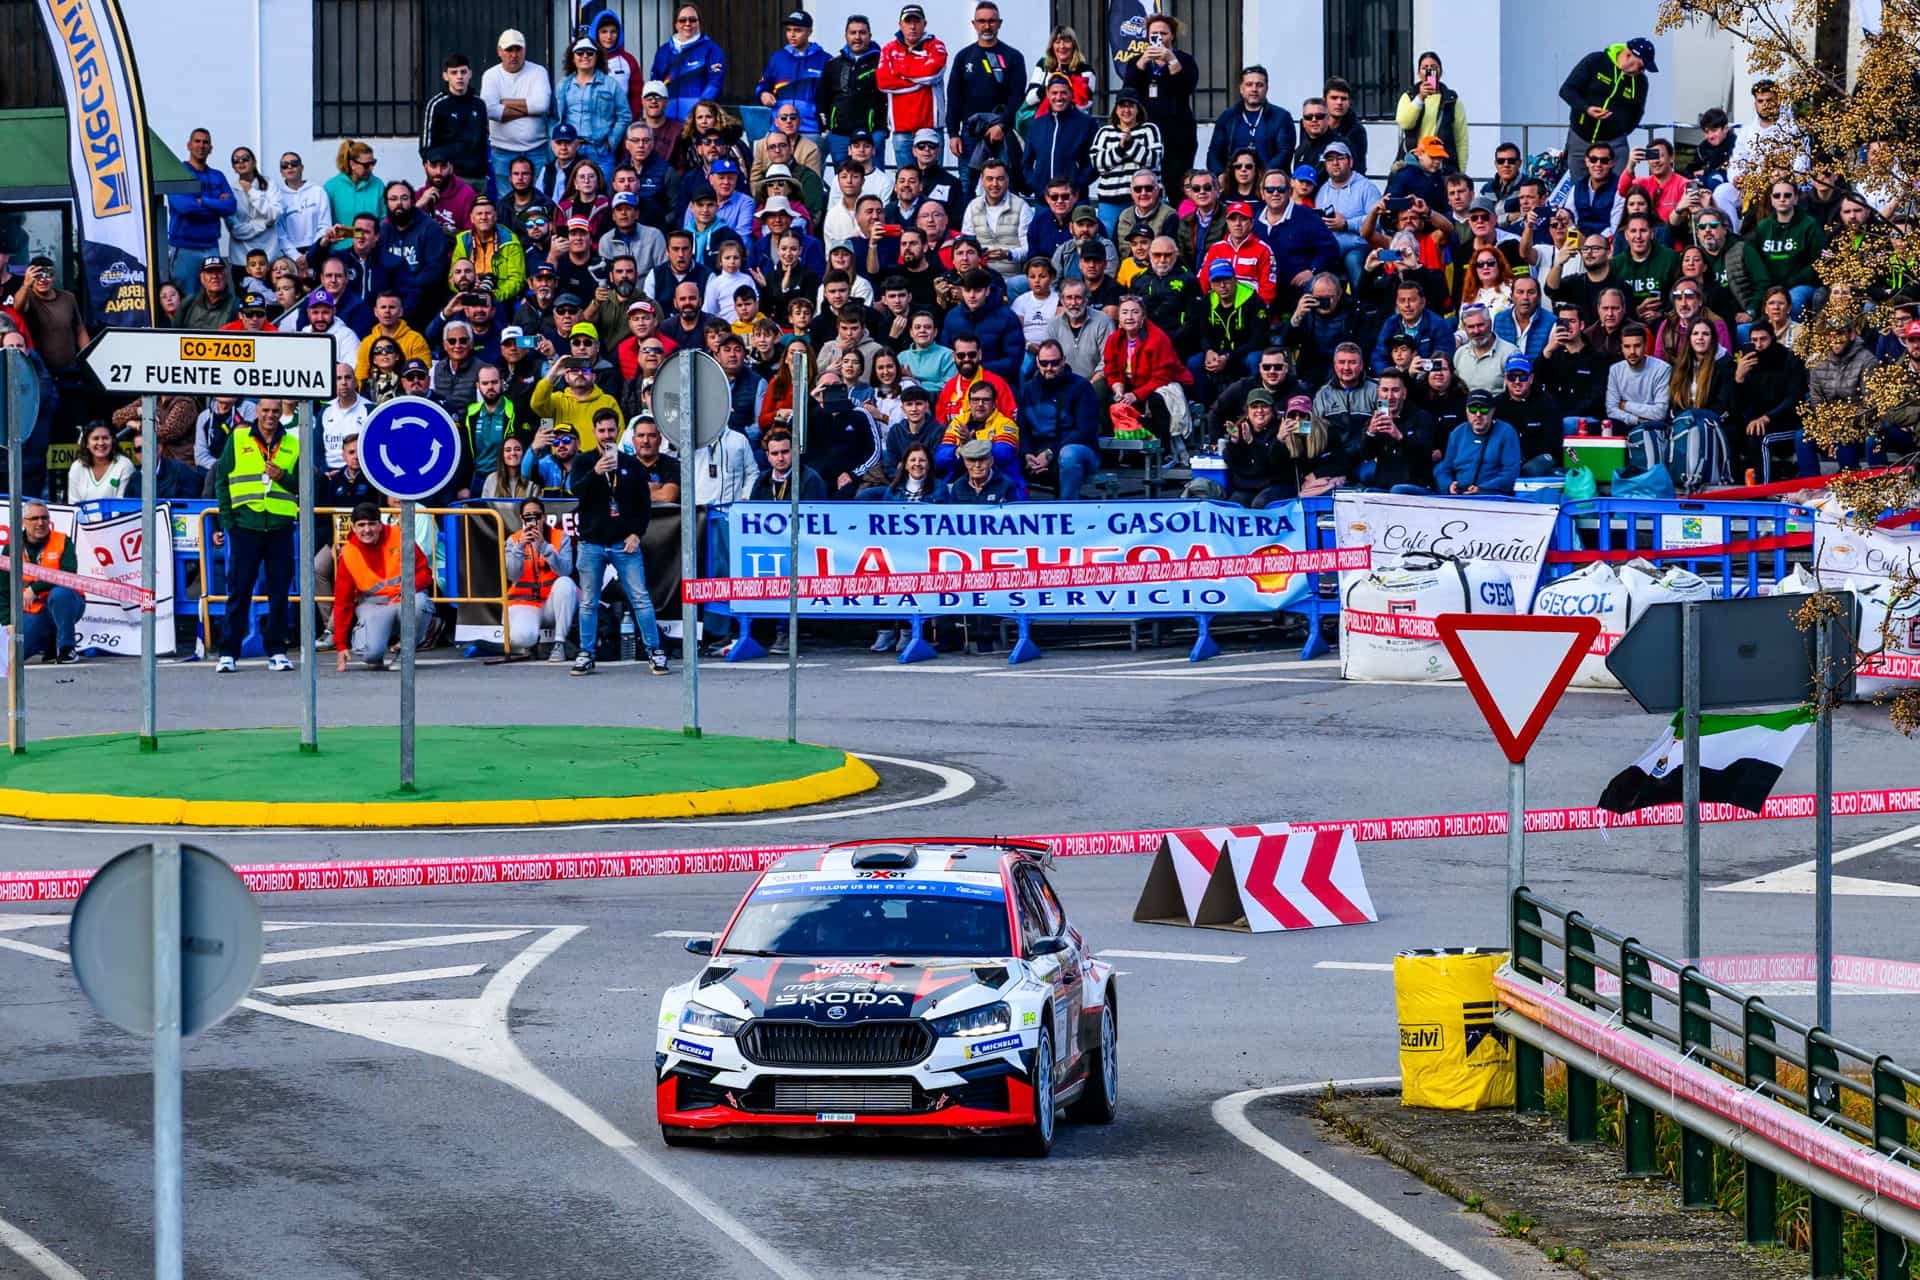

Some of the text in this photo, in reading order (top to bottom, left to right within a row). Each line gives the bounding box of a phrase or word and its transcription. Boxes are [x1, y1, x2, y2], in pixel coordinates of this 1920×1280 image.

[183, 341, 252, 358] CO-7403
[110, 366, 326, 389] 27 FUENTE OBEJUNA
[869, 513, 1074, 536] RESTAURANTE
[1108, 511, 1295, 538] GASOLINERA
[714, 581, 730, 599] ZONA
[733, 580, 764, 597] PROHIBIDO
[766, 579, 790, 597] PUBLICO
[811, 578, 841, 596] PROHIBIDO
[843, 577, 867, 595] PUBLICO
[868, 577, 885, 594] ZONA
[887, 575, 918, 593] PROHIBIDO
[919, 575, 944, 591] PUBLICO
[945, 574, 961, 590] ZONA
[964, 573, 994, 589] PROHIBIDO
[996, 572, 1020, 588] PUBLICO
[1022, 571, 1037, 587] ZONA
[1039, 569, 1070, 586] PROHIBIDO
[1071, 568, 1095, 585] PUBLICO
[1096, 566, 1112, 582] ZONA
[1115, 565, 1145, 581] PROHIBIDO
[1146, 563, 1170, 580] PUBLICO
[1171, 562, 1187, 578] ZONA
[1189, 561, 1219, 577] PROHIBIDO
[1221, 559, 1245, 576] PUBLICO
[1246, 558, 1262, 574] ZONA
[1263, 556, 1294, 573] PROHIBIDO
[1295, 554, 1319, 570] PUBLICO
[1321, 552, 1336, 568] ZONA
[1338, 550, 1368, 567] PROHIBIDO
[939, 592, 988, 607] DE
[1009, 589, 1227, 607] SERVICIO
[1539, 591, 1614, 616] GECOL
[1375, 616, 1396, 633] ZONA
[38, 880, 79, 898] PUBLICO
[243, 873, 294, 891] PROHIBIDO
[298, 868, 339, 890] PUBLICO
[343, 869, 368, 888] ZONA
[373, 867, 423, 886] PROHIBIDO
[428, 866, 468, 884] PUBLICO
[471, 864, 497, 881] ZONA
[501, 862, 552, 881] PROHIBIDO
[556, 860, 596, 878] PUBLICO
[600, 858, 625, 875] ZONA
[630, 856, 680, 874] PROHIBIDO
[685, 854, 725, 872] PUBLICO
[728, 853, 754, 870] ZONA
[1066, 836, 1105, 854] PUBLICO
[1110, 834, 1135, 852] ZONA
[1362, 822, 1387, 840] ZONA
[1391, 820, 1441, 839] PROHIBIDO
[1445, 818, 1484, 835] PUBLICO
[1569, 810, 1609, 828] PUBLICO
[1642, 804, 1683, 824] PROHIBID
[1699, 802, 1732, 820] UBLICO
[1765, 797, 1814, 817] PROHIBIDO
[1860, 793, 1885, 811] ZONA
[982, 1037, 1020, 1052] MICHELIN
